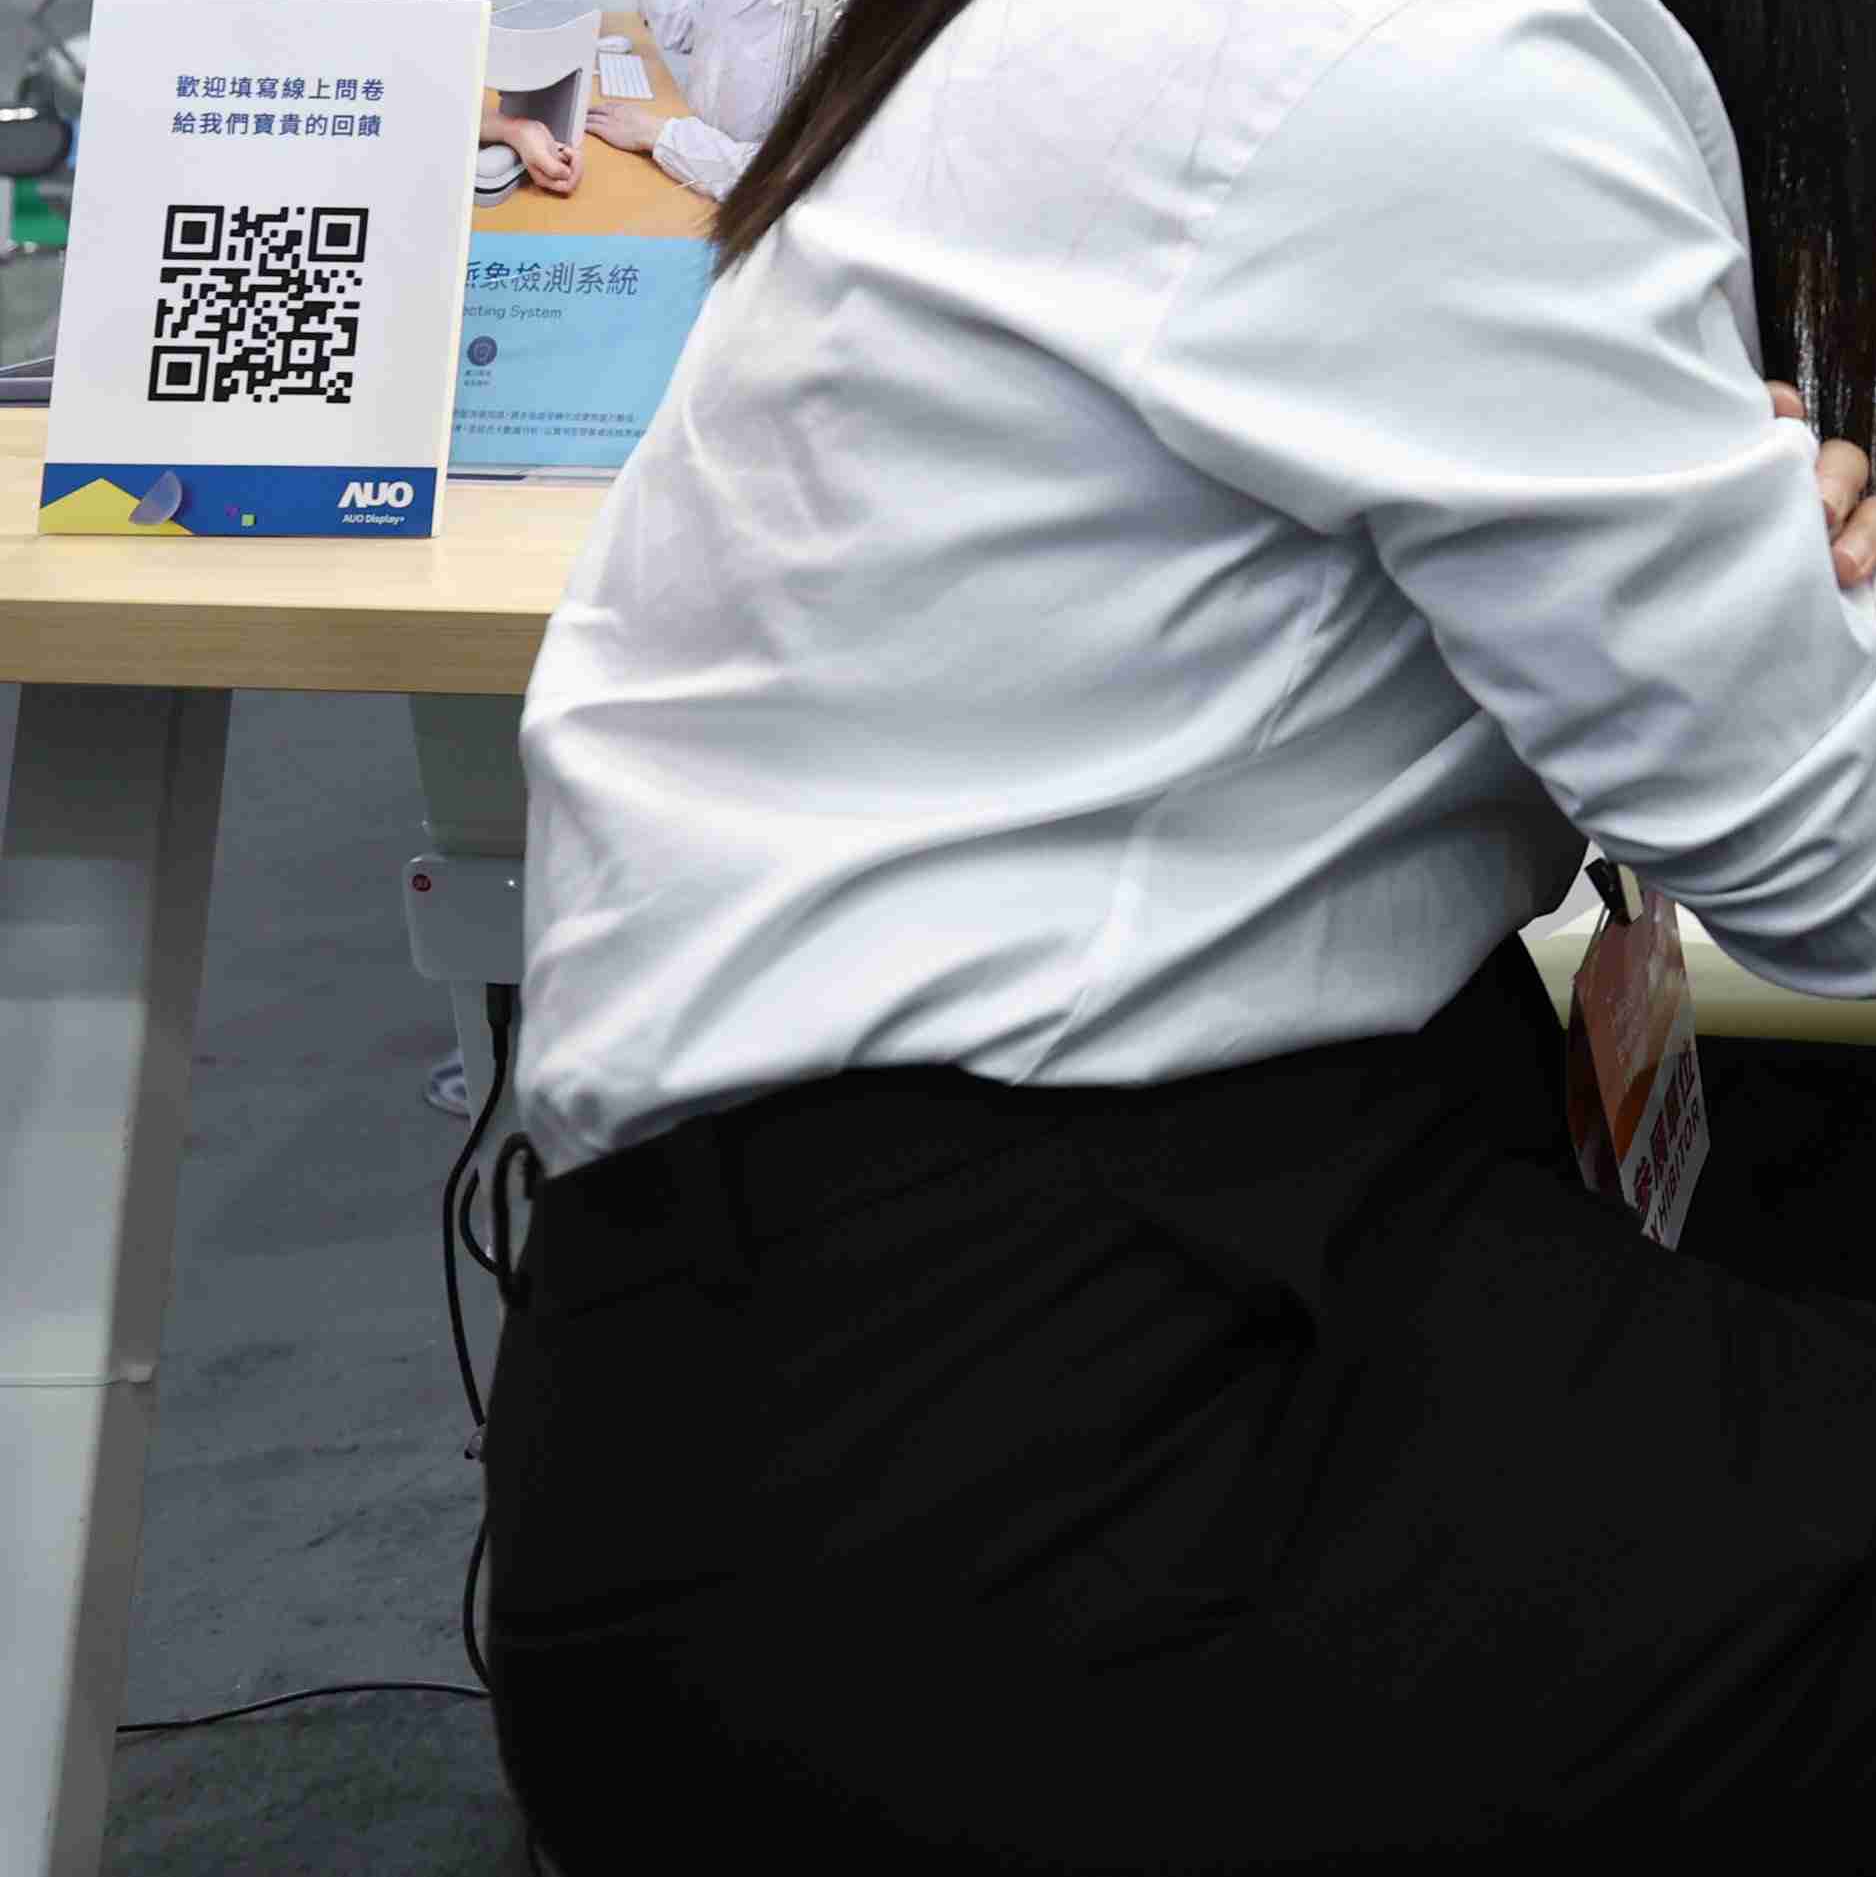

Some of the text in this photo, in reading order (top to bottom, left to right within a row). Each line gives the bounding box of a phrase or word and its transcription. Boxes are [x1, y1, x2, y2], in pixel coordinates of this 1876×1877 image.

[176, 75, 384, 101] 歡迎填寫線上問卷
[172, 111, 382, 137] 給我們寶貴的回饋
[509, 305, 562, 320] System
[337, 481, 415, 508] AUO
[342, 514, 364, 524] AUO
